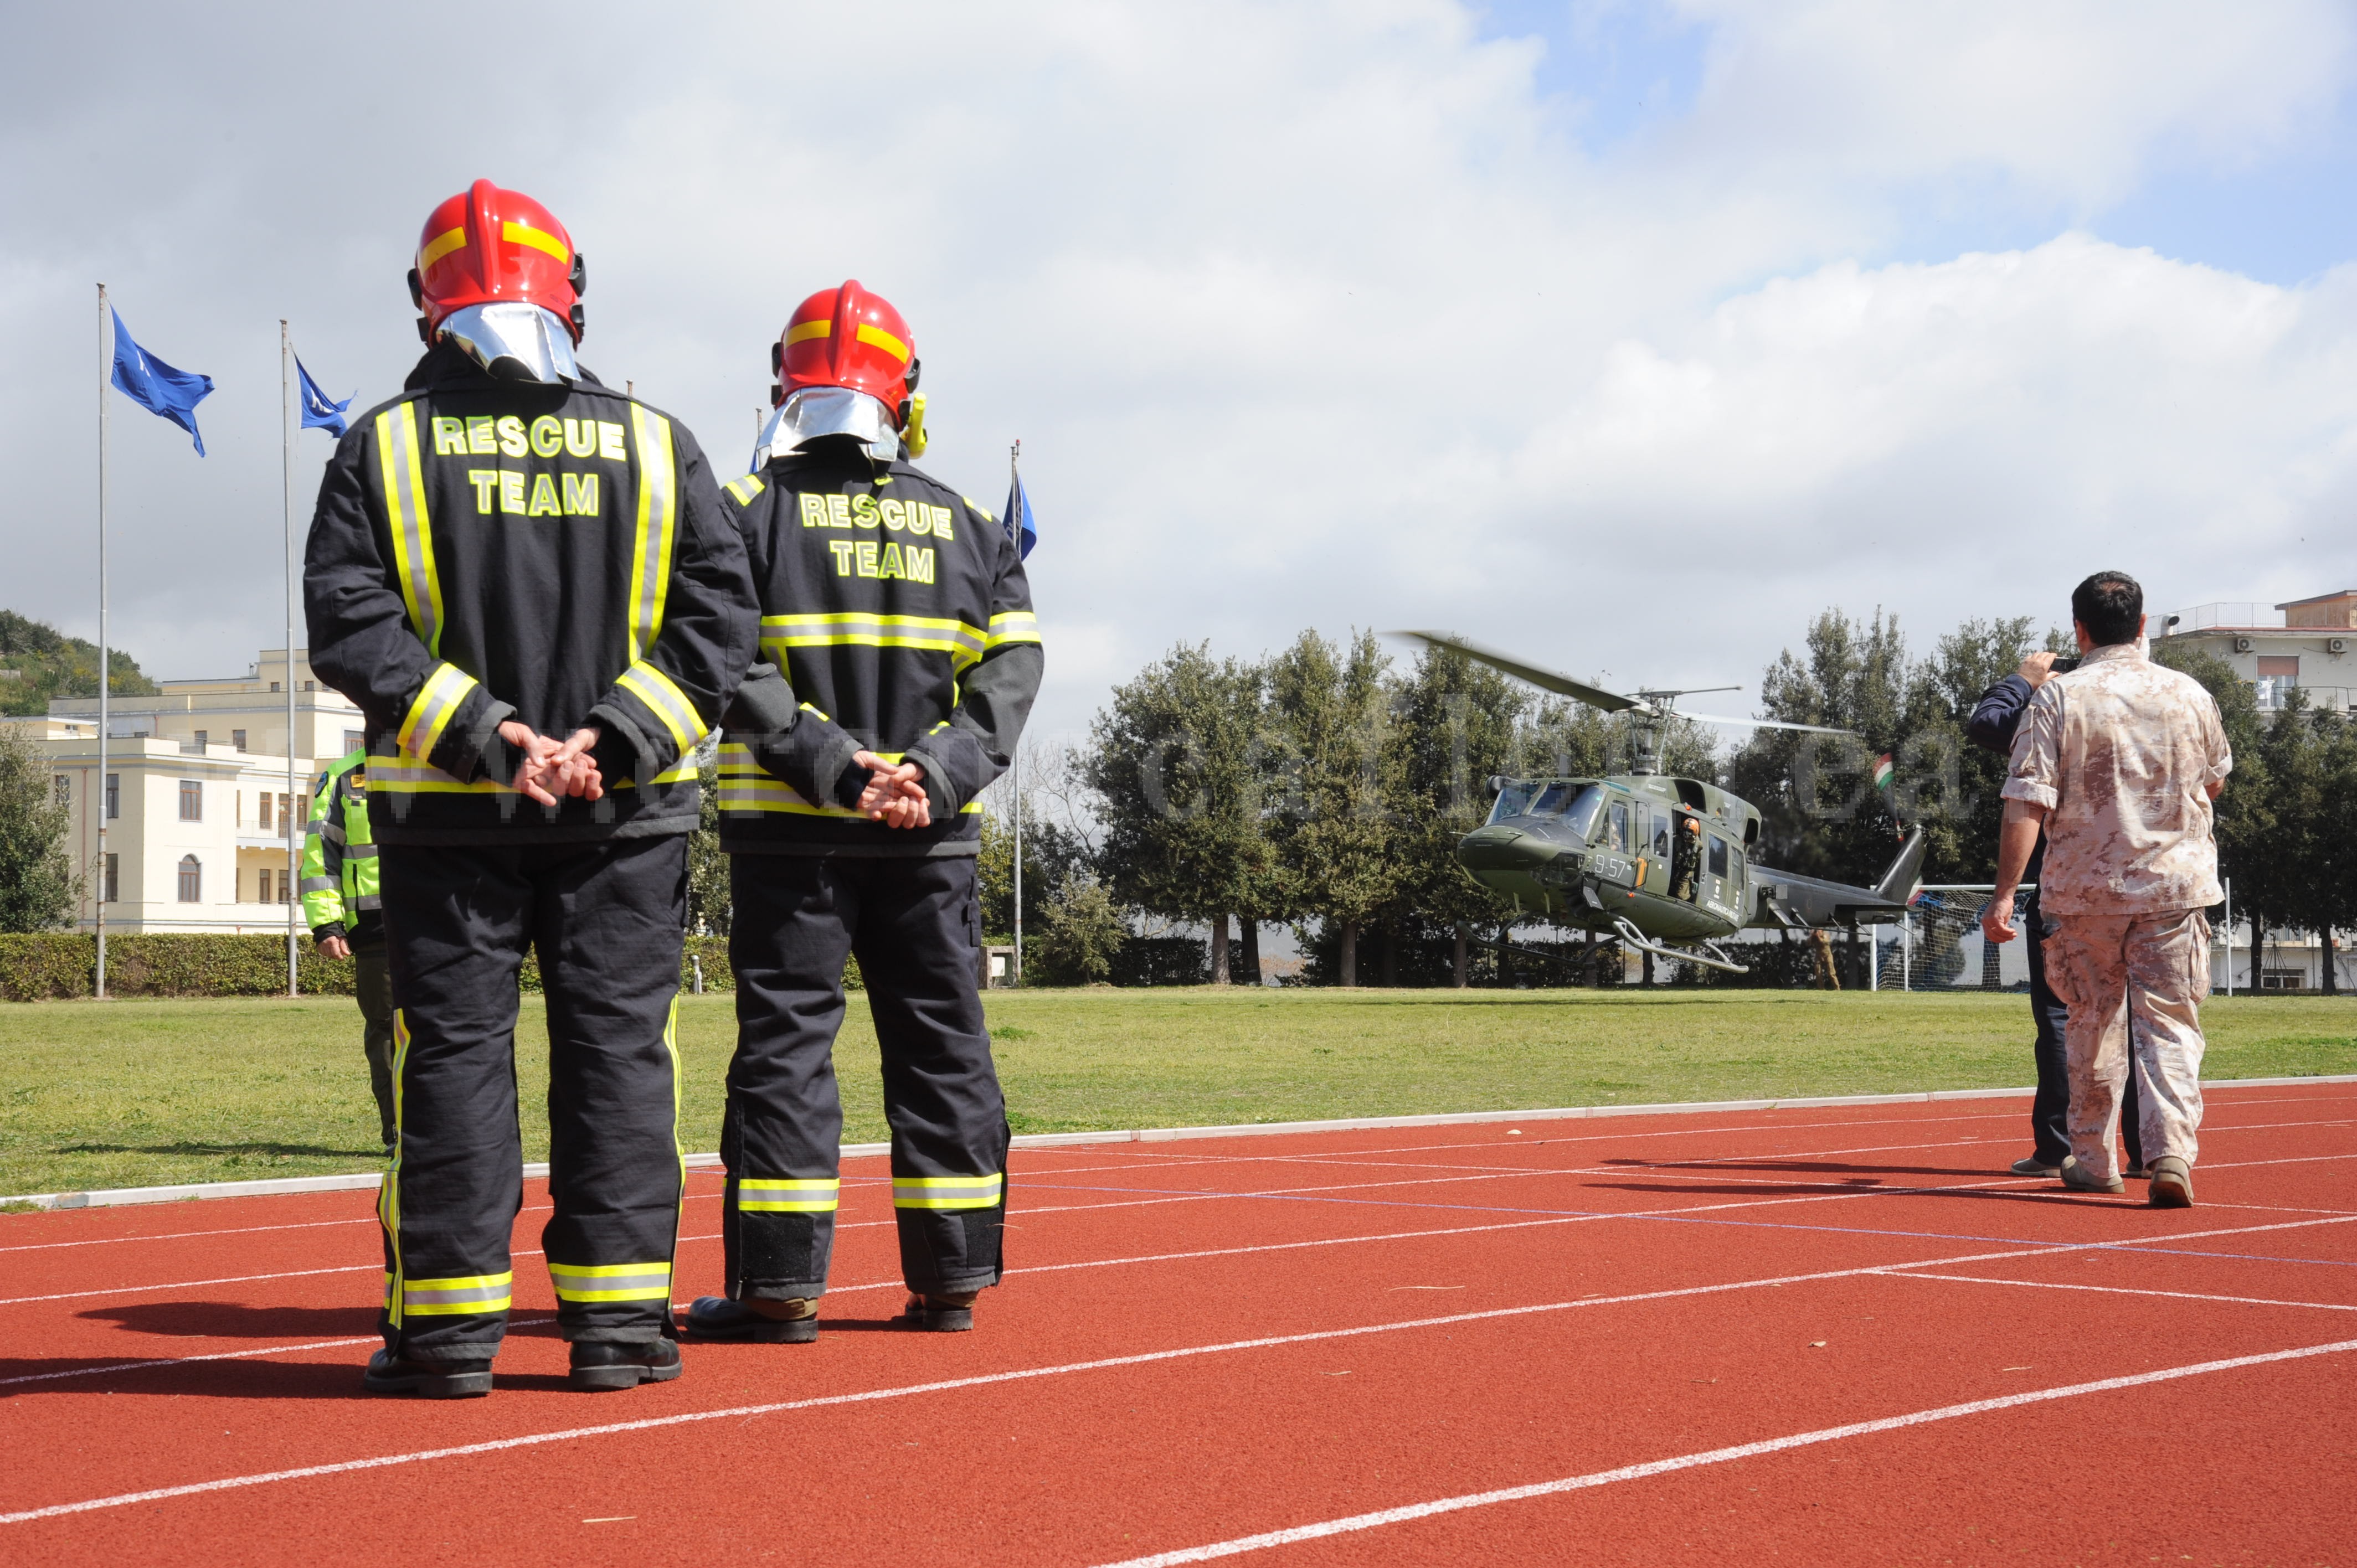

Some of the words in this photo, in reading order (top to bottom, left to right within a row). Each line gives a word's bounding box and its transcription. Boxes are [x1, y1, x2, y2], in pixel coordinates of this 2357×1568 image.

[431, 415, 626, 462] RESCUE
[469, 470, 599, 517] TEAM
[799, 493, 954, 541] RESCUE
[829, 540, 934, 585] TEAM
[1594, 854, 1626, 879] 9-57
